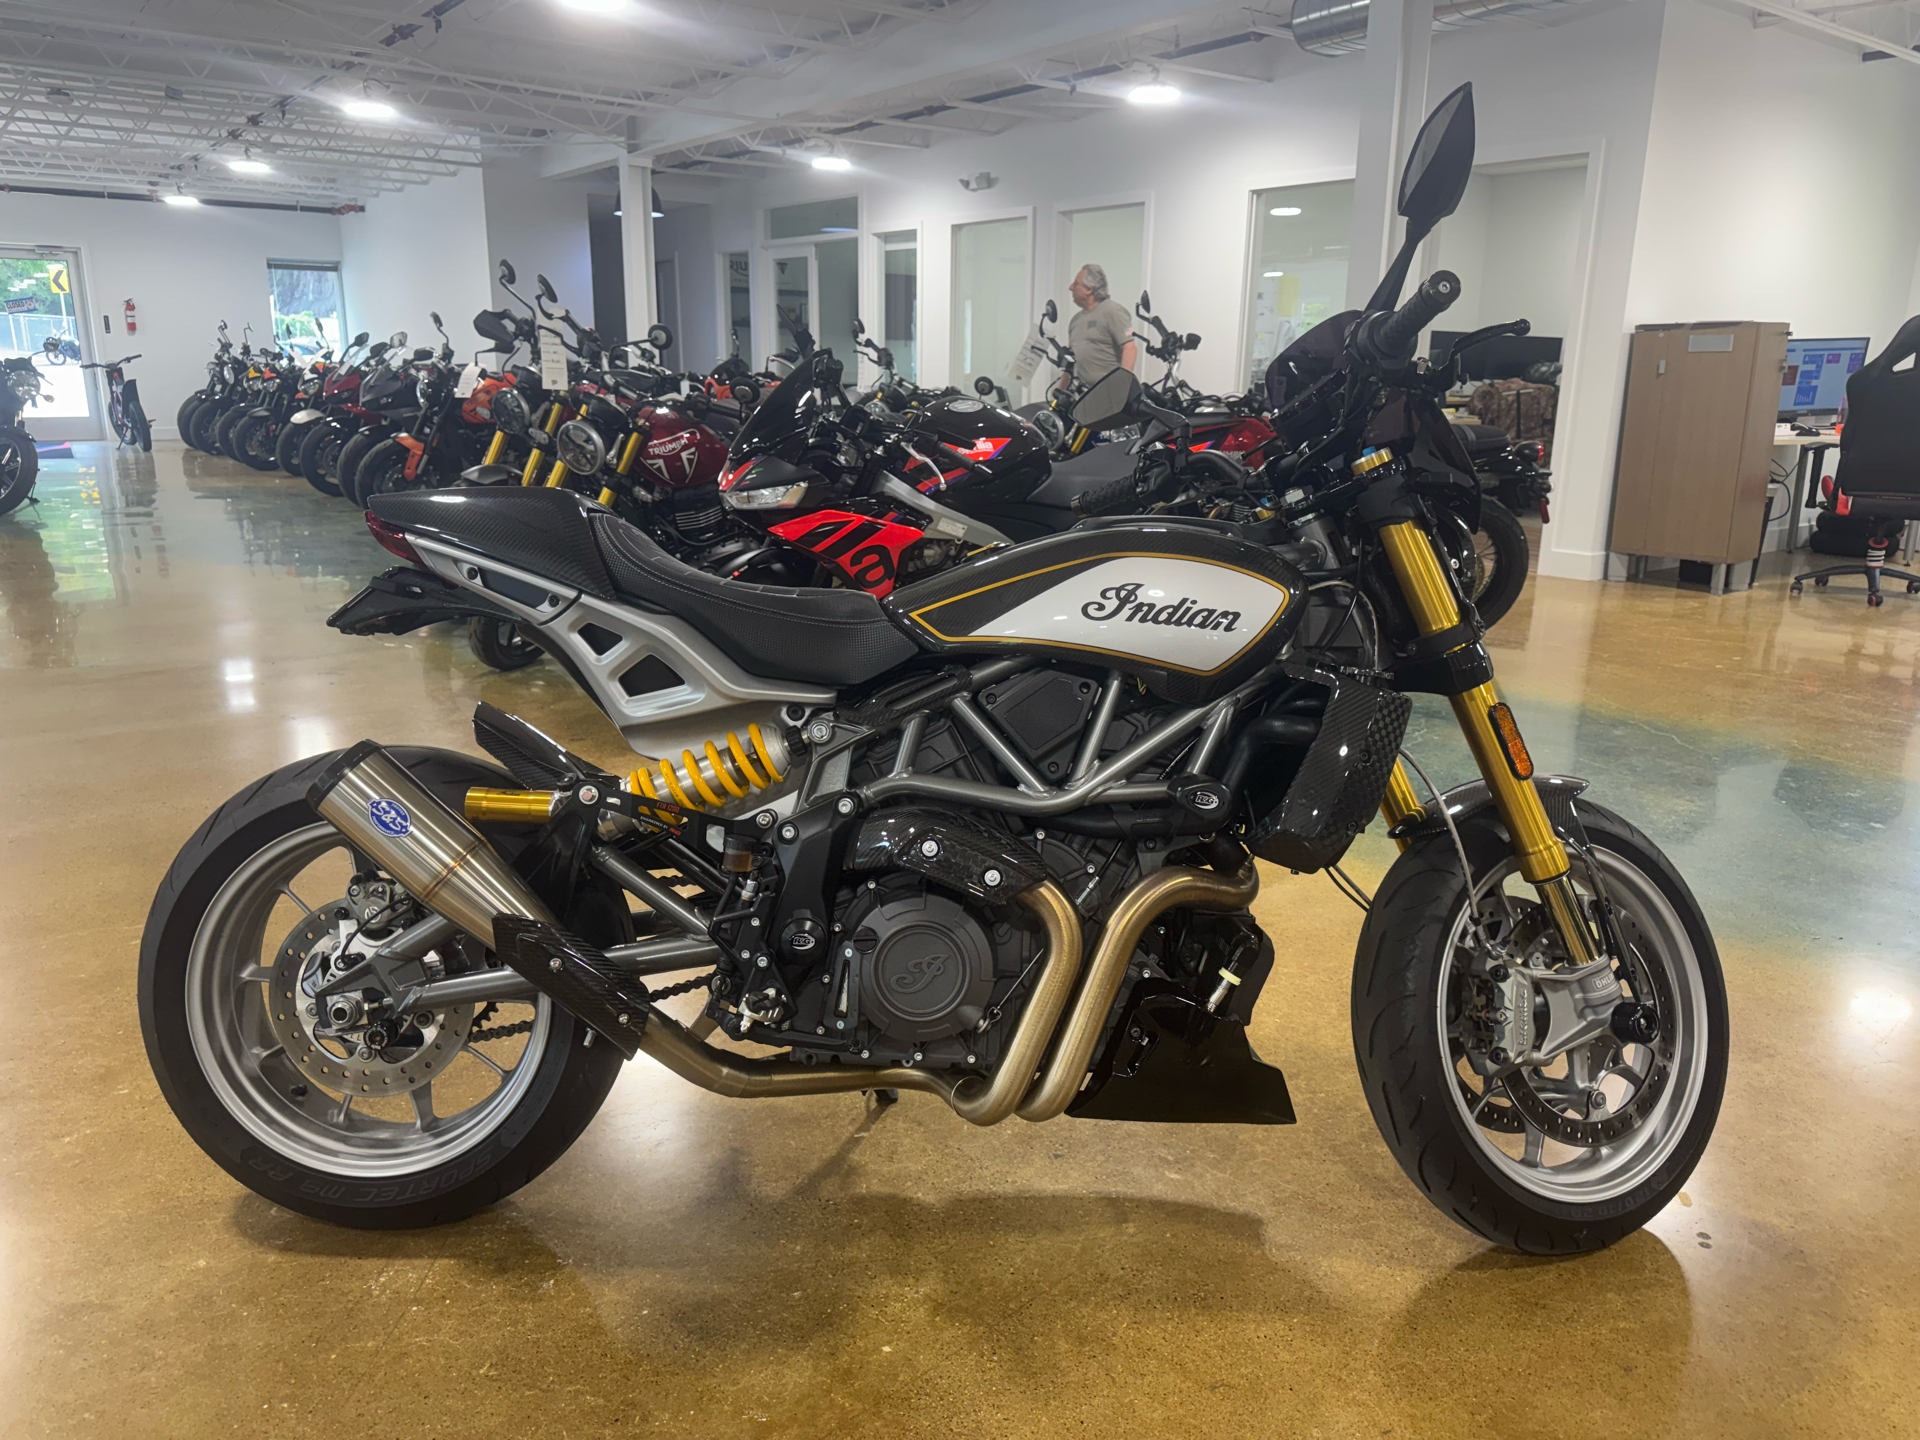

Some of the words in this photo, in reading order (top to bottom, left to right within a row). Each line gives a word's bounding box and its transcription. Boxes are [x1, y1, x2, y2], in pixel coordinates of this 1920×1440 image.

[648, 437, 688, 455] TRIUMPH
[1081, 583, 1241, 632] Indian
[372, 801, 408, 830] S&S
[357, 1149, 492, 1202] SPORTEC
